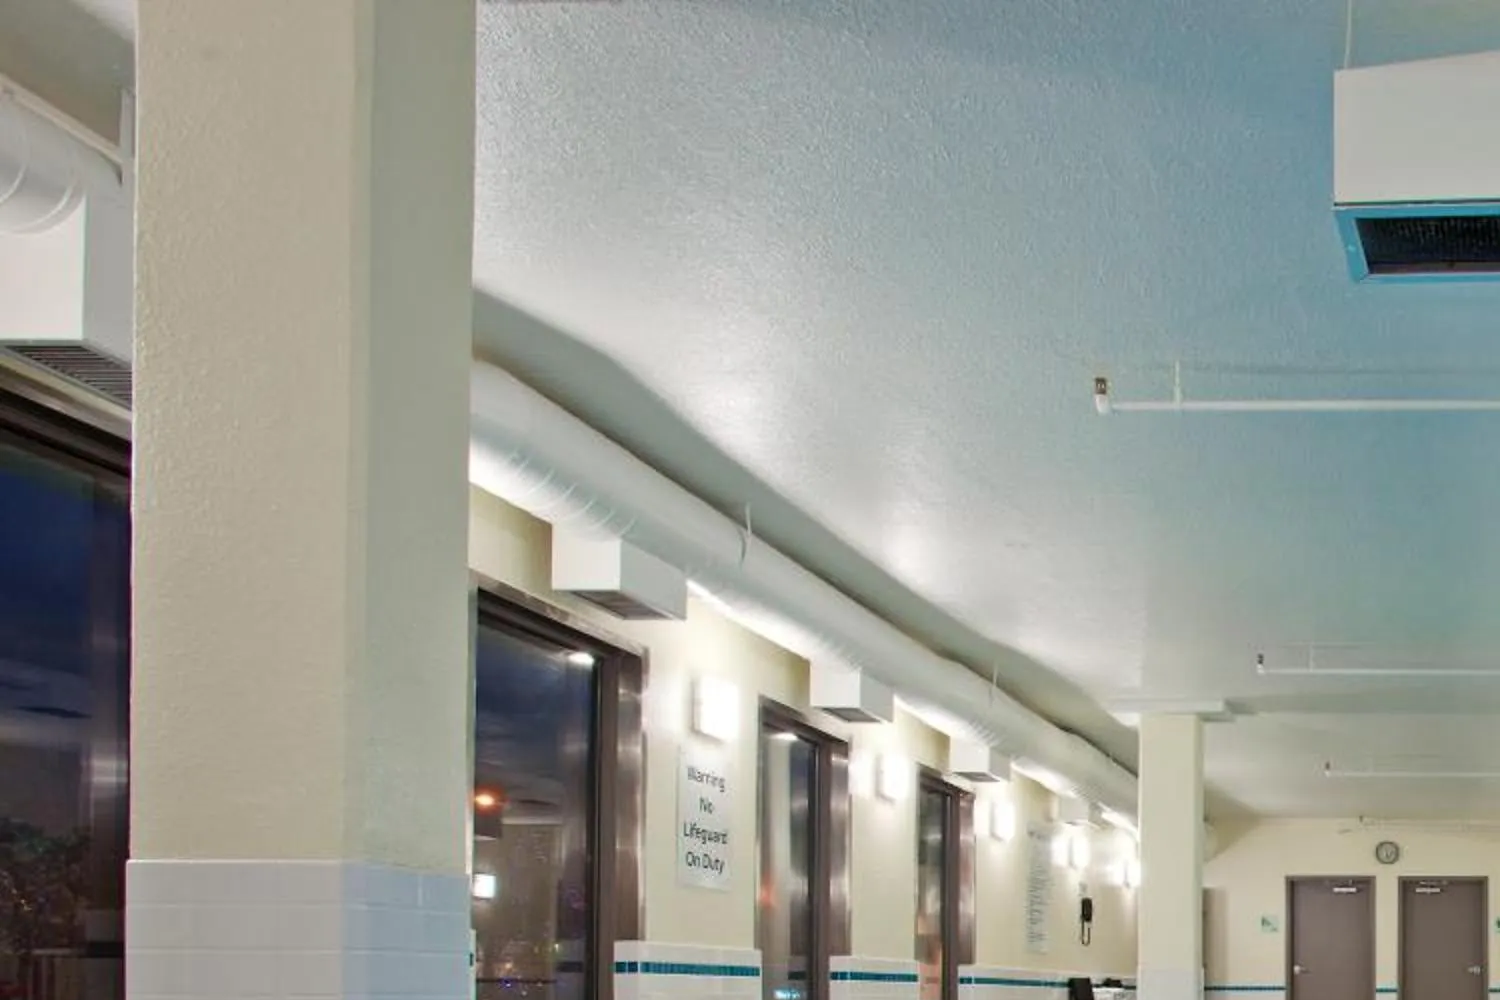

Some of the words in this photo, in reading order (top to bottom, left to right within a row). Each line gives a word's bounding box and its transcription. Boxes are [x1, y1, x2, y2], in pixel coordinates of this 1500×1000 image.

[687, 767, 725, 792] Warning
[699, 798, 714, 814] No
[683, 823, 727, 844] Lifeguard
[686, 851, 700, 867] On
[702, 853, 724, 874] Duty
